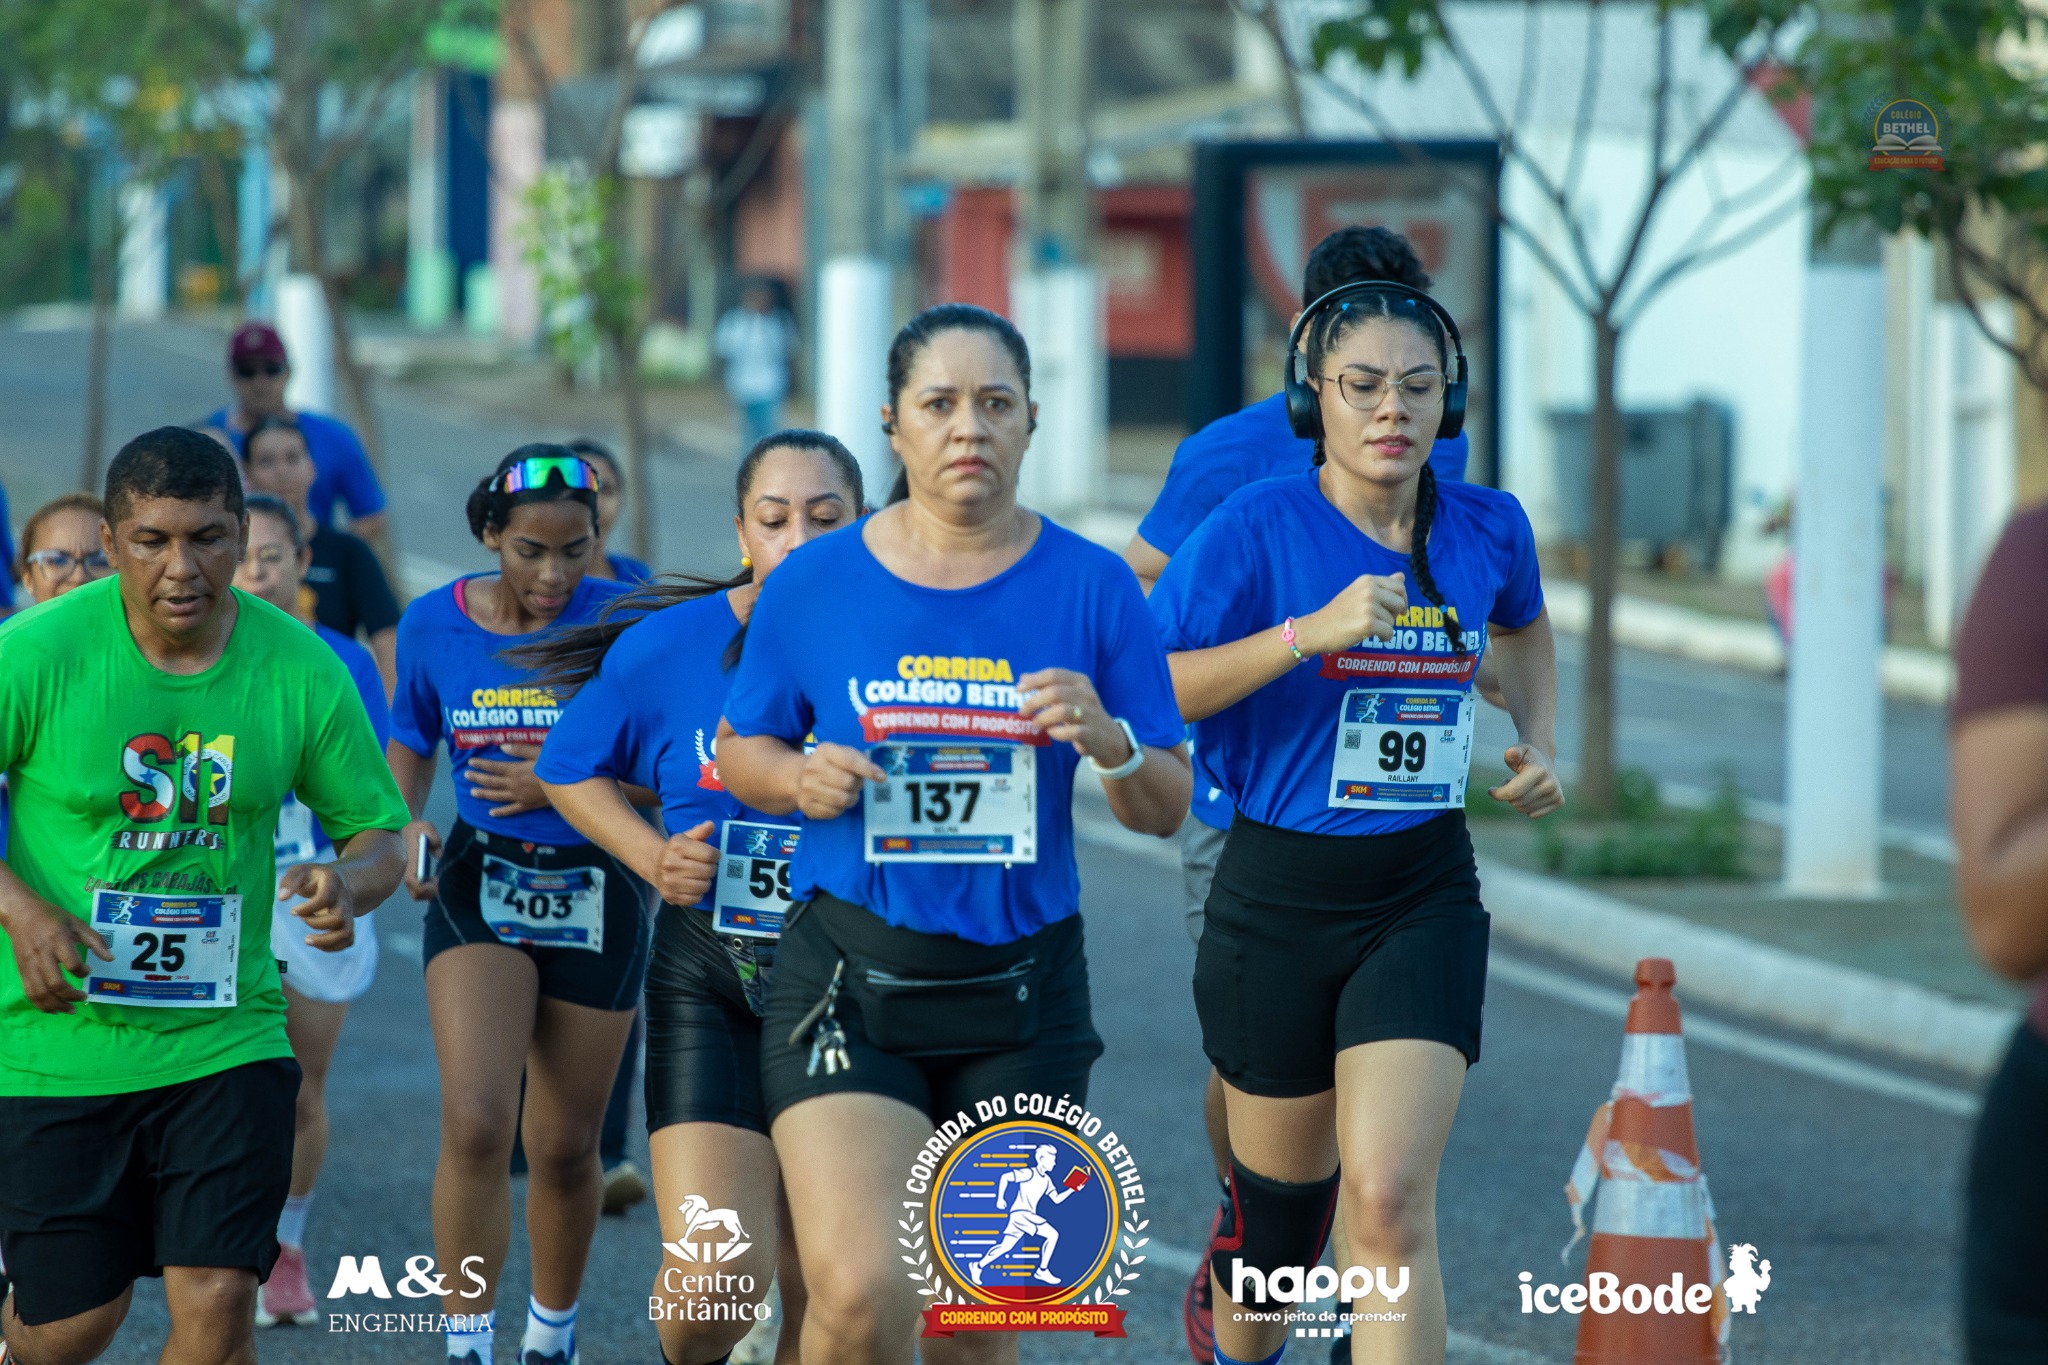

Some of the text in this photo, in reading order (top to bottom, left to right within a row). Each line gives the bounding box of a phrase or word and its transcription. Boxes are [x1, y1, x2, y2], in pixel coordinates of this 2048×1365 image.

[1395, 606, 1459, 628] RRIDA
[1353, 630, 1418, 651] LÉGIO
[897, 655, 1013, 683] CORRIDA
[1337, 657, 1471, 674] CORRENDO COM PROPÓSITO
[471, 688, 558, 708] CORRIDA
[865, 676, 1028, 708] COLÉGIO BETH
[452, 707, 519, 727] COLÉGIO
[873, 712, 1041, 736] CORRENDO COM PROPÓSITO
[1378, 730, 1427, 773] 99
[1350, 785, 1368, 793] 5KM
[1387, 774, 1420, 783] RAILLANY
[905, 781, 982, 824] 137
[119, 828, 221, 850] RUNNERS
[151, 870, 214, 894] CARAJÁS
[503, 887, 573, 920] 403
[130, 932, 187, 973] 25
